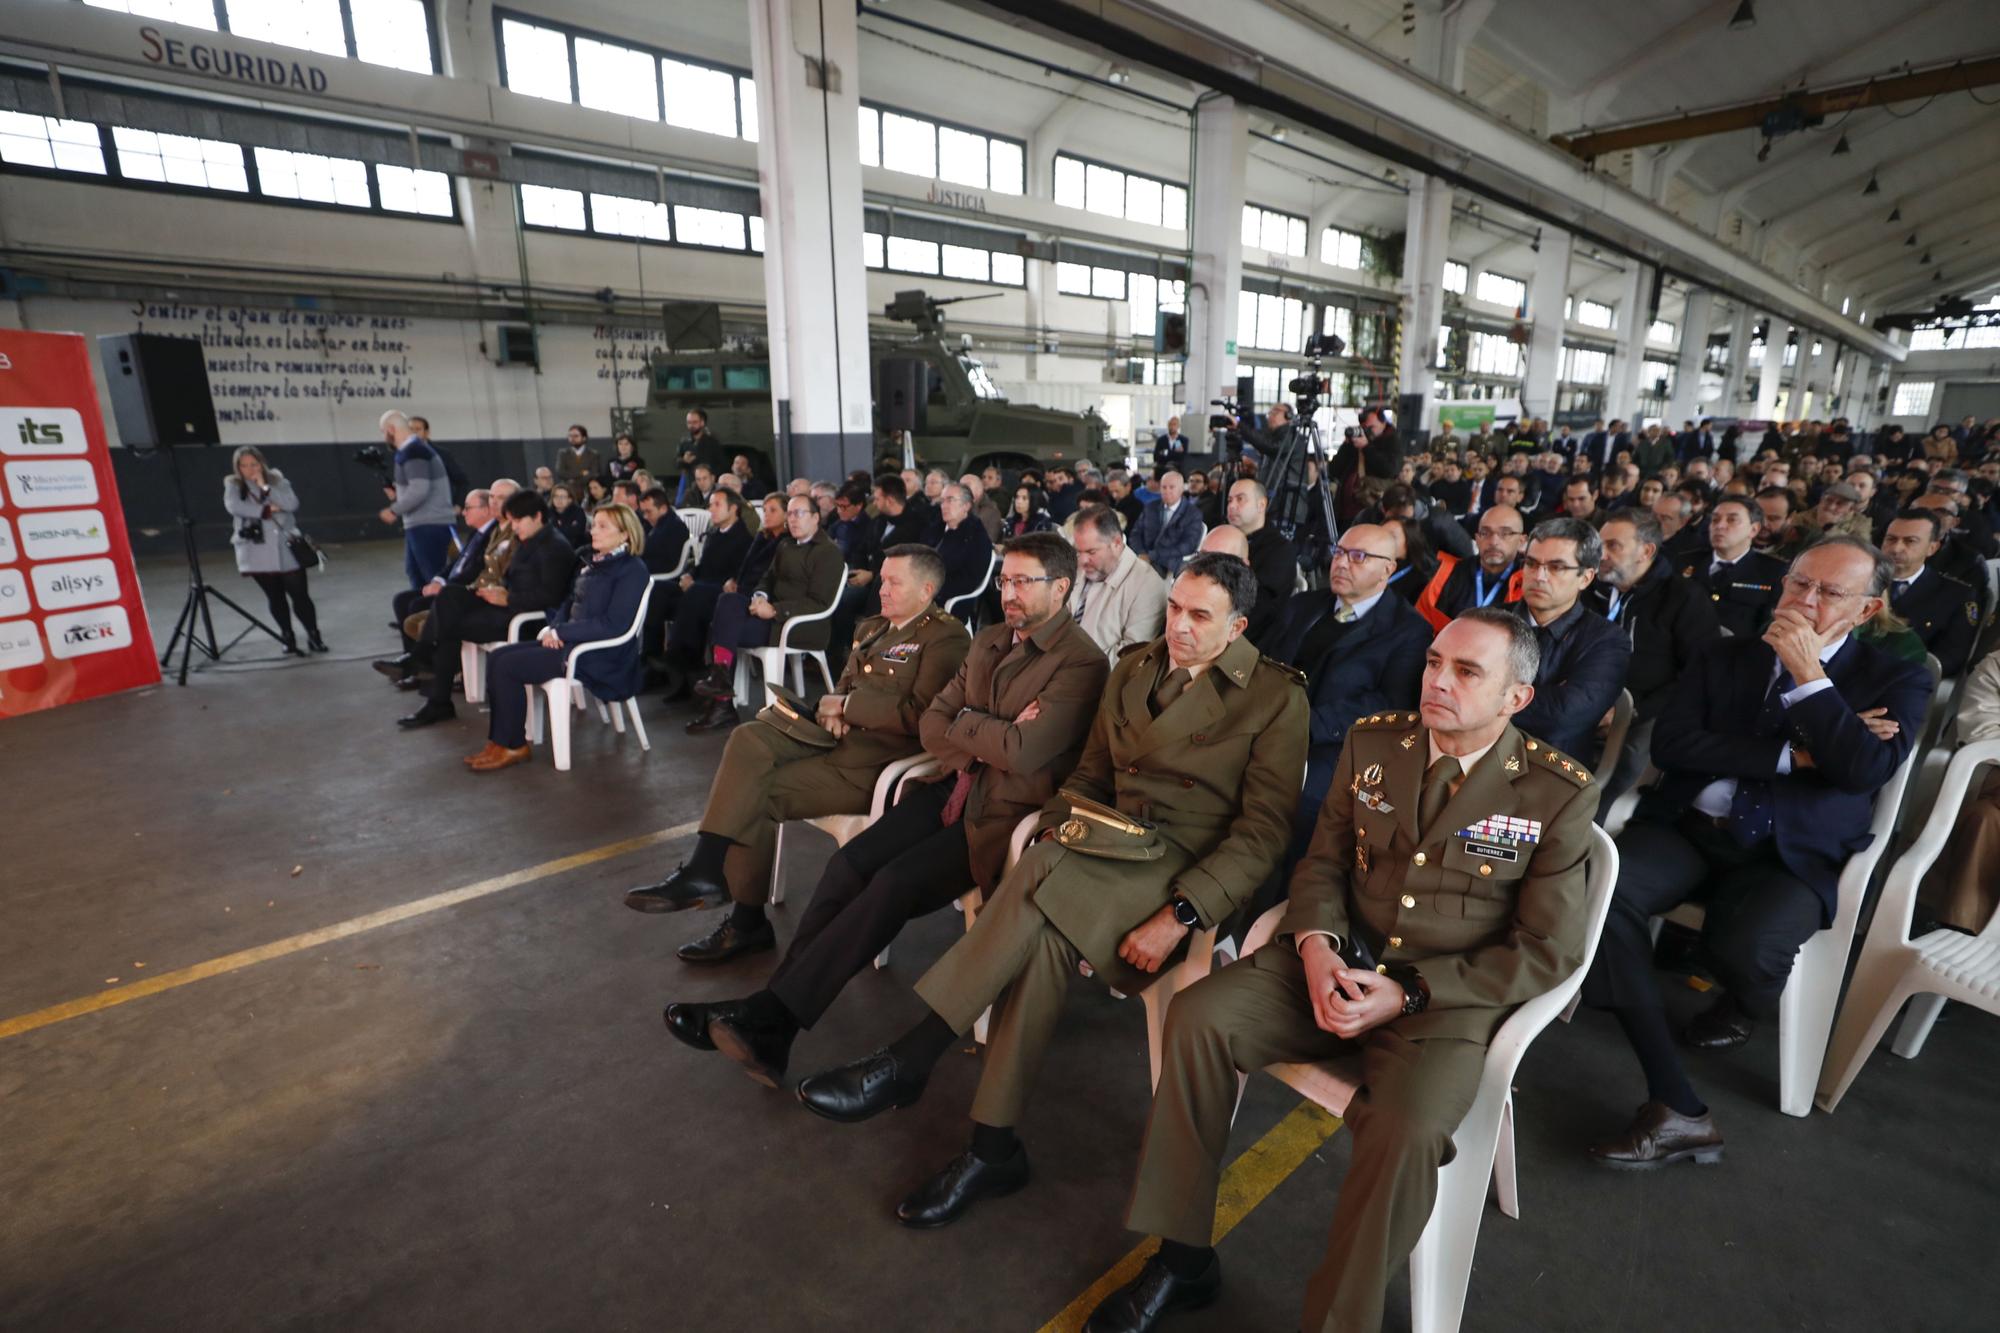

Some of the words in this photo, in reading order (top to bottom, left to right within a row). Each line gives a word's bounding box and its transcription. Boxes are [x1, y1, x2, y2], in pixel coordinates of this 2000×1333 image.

[139, 26, 328, 93] SEGURIDAD
[927, 182, 986, 213] JUSTICIA
[206, 304, 221, 322] el
[279, 308, 298, 325] de
[303, 311, 364, 331] mejorar
[351, 340, 369, 352] en
[208, 352, 270, 374] nuestra
[380, 364, 389, 381] y
[213, 378, 280, 401] siempre
[283, 377, 299, 398] la
[390, 378, 412, 398] del
